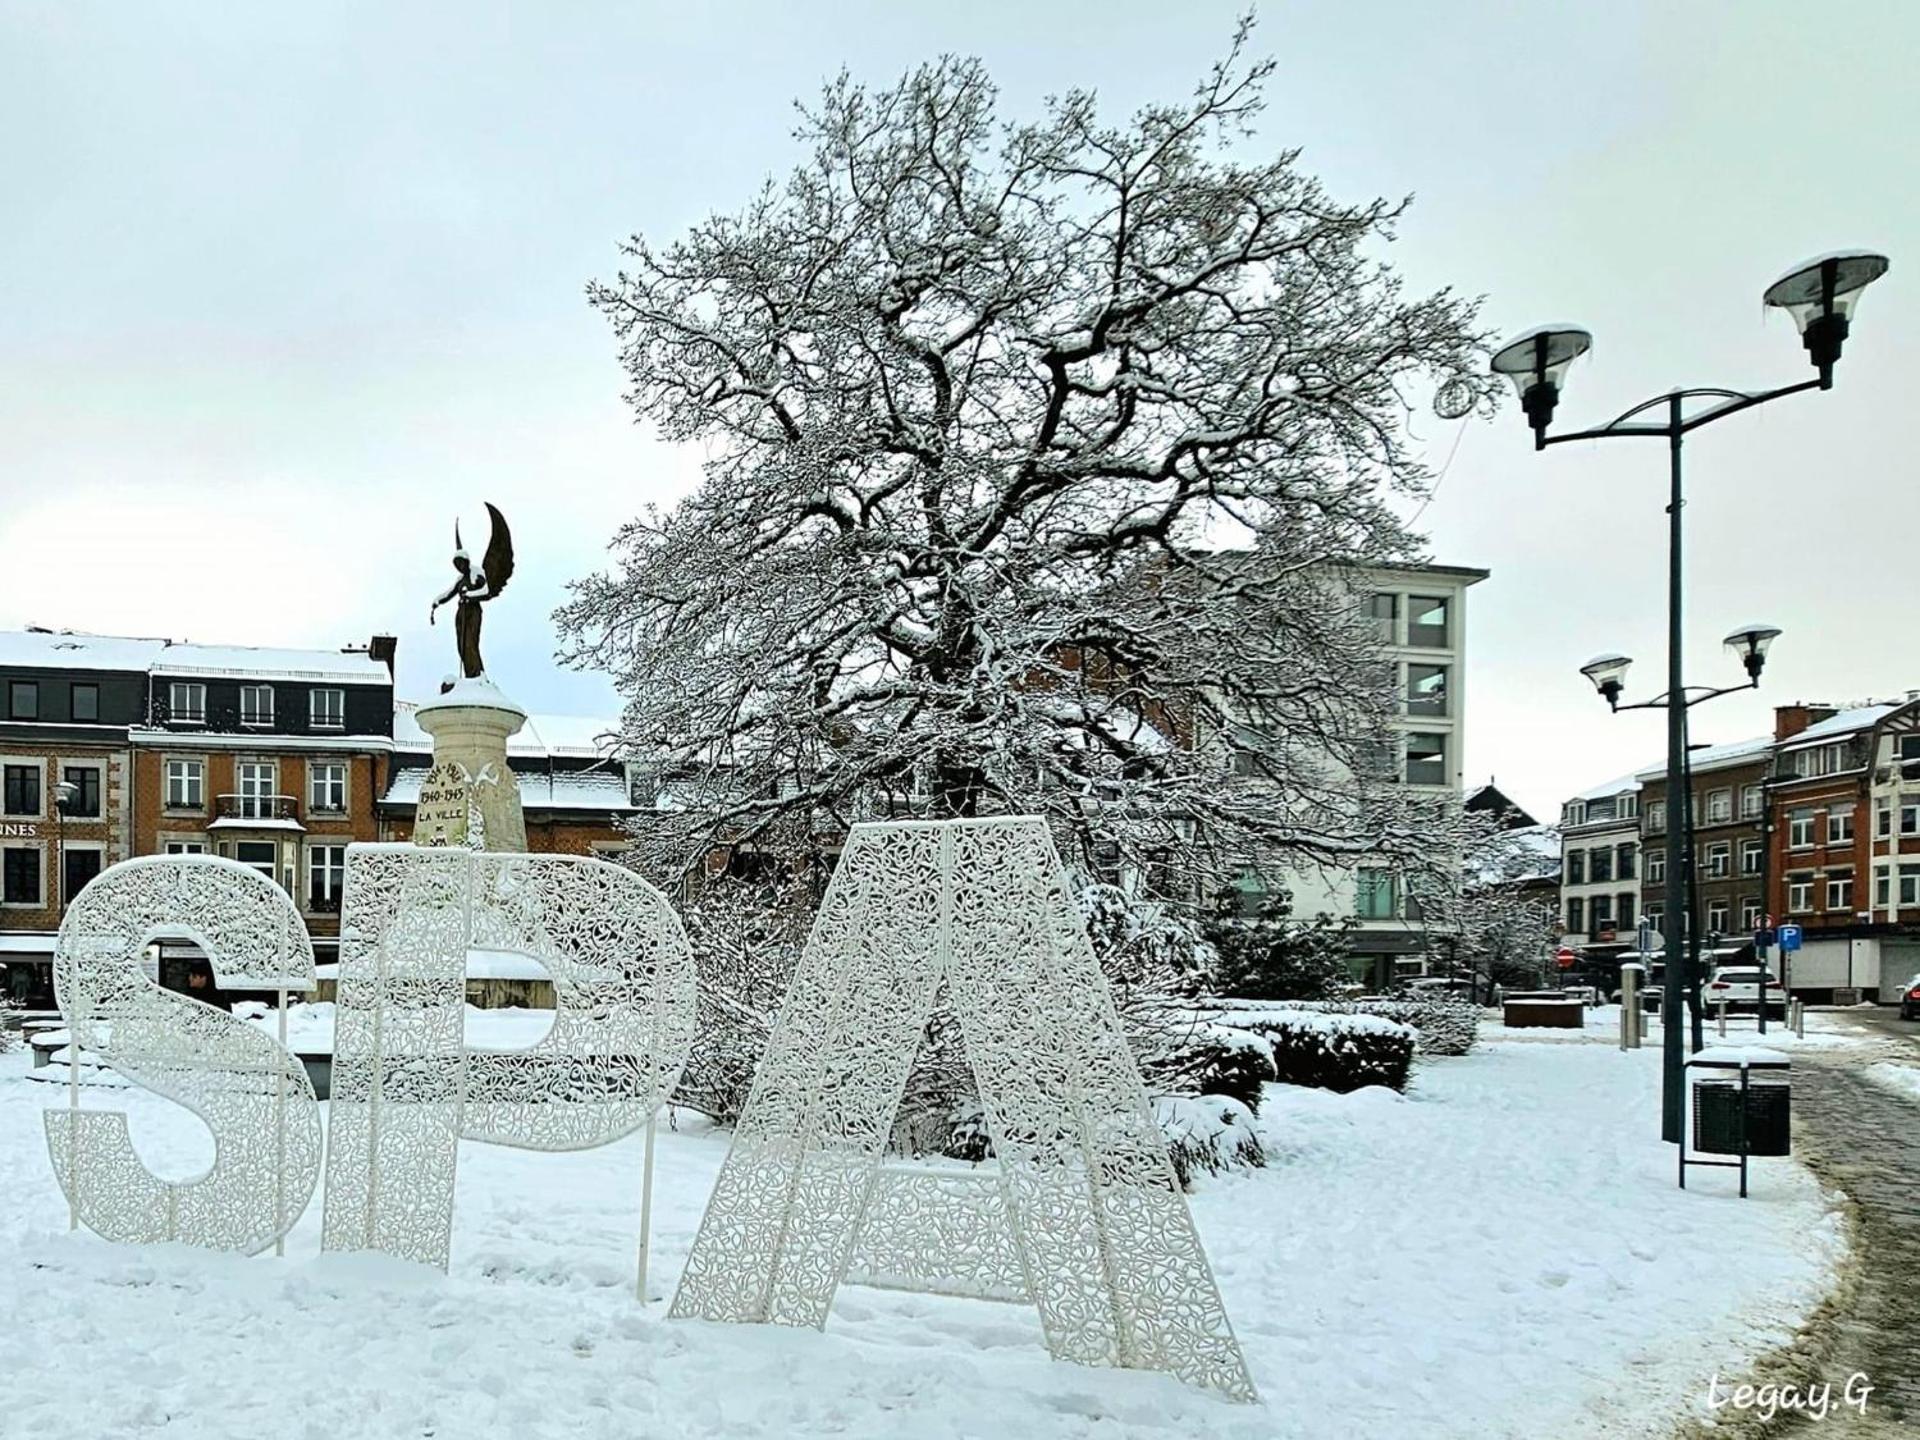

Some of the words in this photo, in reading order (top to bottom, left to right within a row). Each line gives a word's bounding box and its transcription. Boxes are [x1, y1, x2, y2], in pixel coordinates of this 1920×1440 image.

[421, 788, 464, 804] 1940-1945
[419, 813, 431, 822] LA
[436, 809, 463, 819] VILLE
[0, 823, 37, 837] NES
[1784, 928, 1797, 941] P
[45, 814, 1257, 1401] SPA
